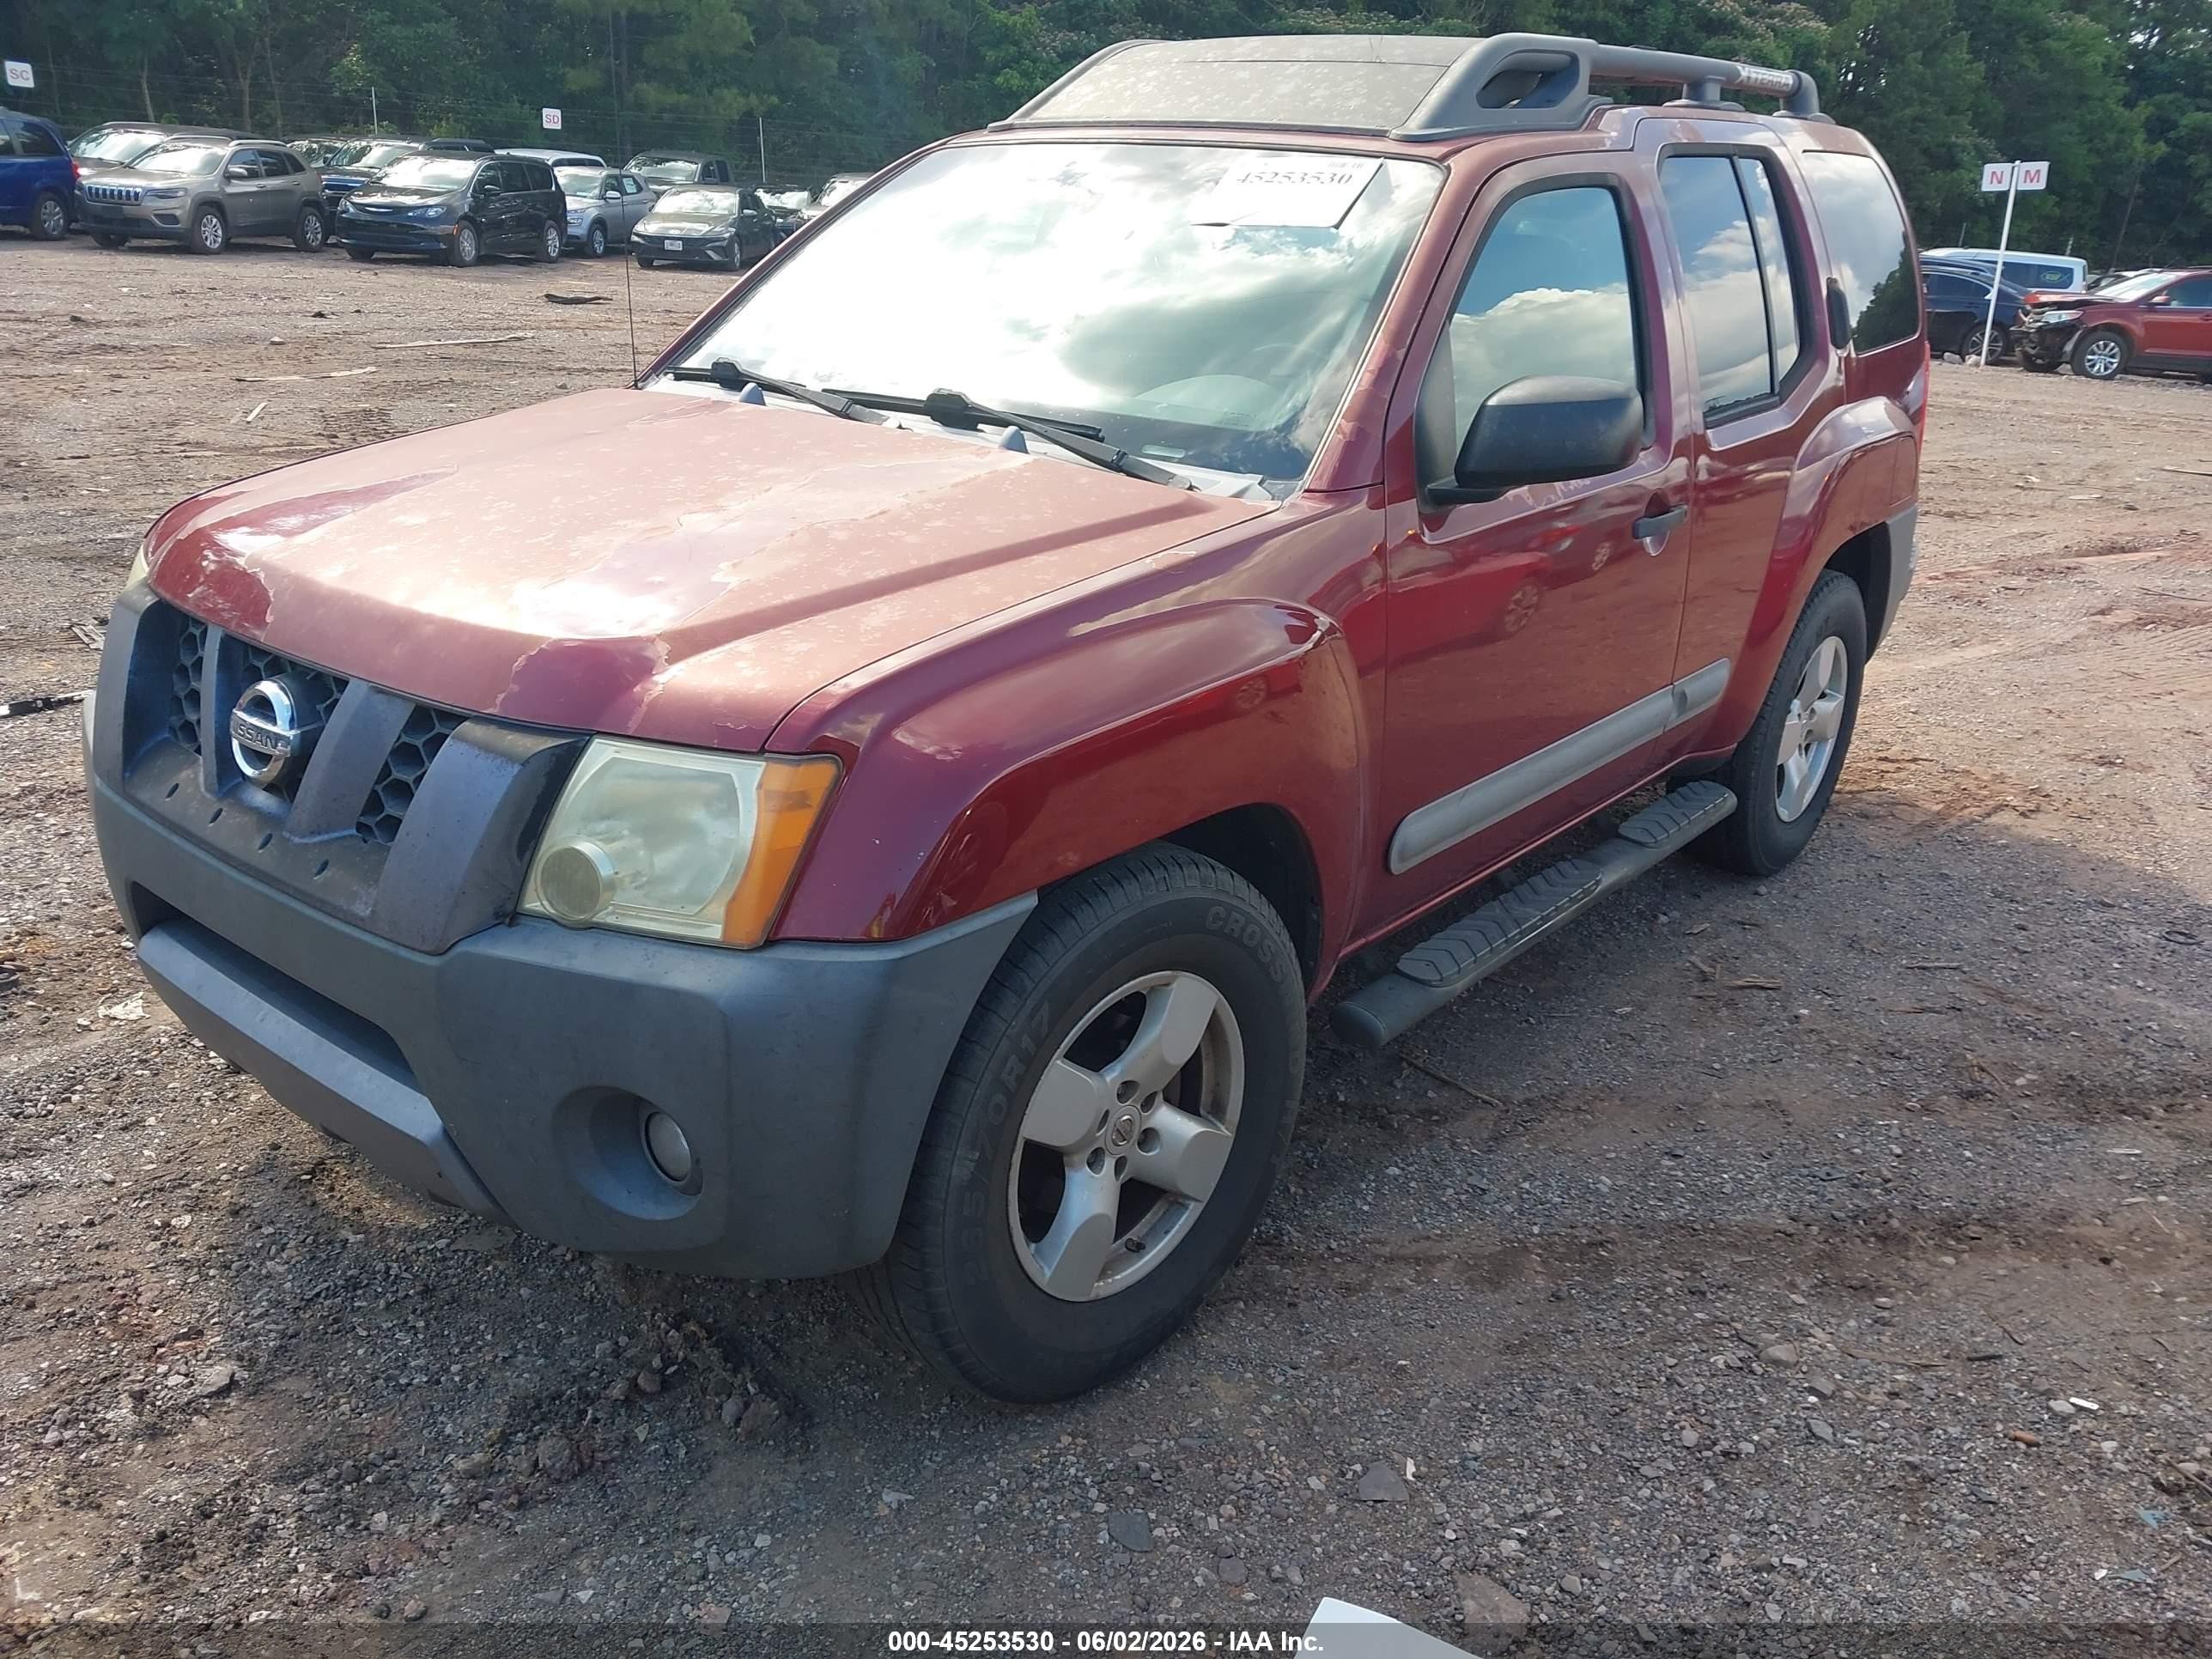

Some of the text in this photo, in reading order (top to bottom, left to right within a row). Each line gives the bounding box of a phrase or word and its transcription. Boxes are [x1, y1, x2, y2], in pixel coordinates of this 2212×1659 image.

[9, 69, 30, 82] SC
[544, 113, 560, 125] SD
[1237, 171, 1353, 185] 45253530
[1990, 170, 2004, 185] N
[2023, 168, 2041, 184] M
[234, 721, 276, 750] ISSAN
